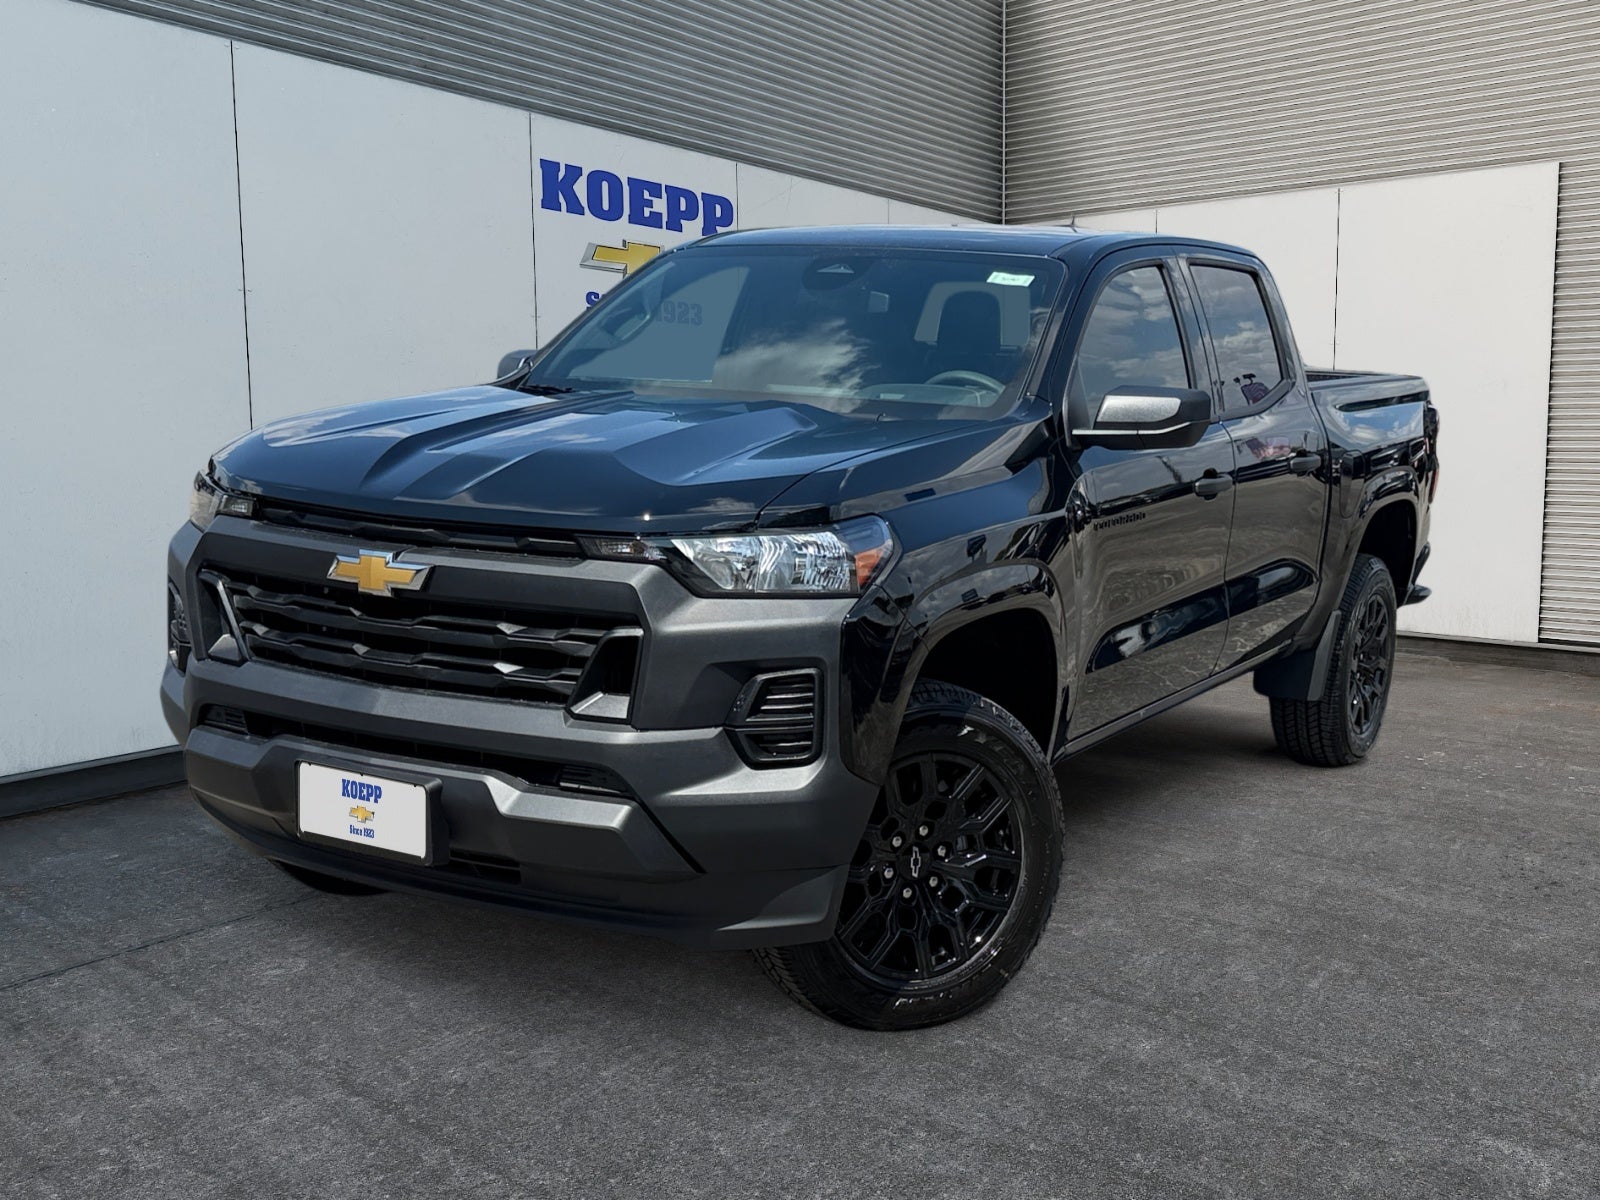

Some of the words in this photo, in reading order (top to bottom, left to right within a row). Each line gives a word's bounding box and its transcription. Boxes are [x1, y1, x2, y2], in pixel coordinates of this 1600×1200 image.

[539, 158, 734, 237] KOEPP
[341, 778, 383, 804] KOEPP
[349, 824, 363, 837] Since
[363, 827, 375, 839] 1923
